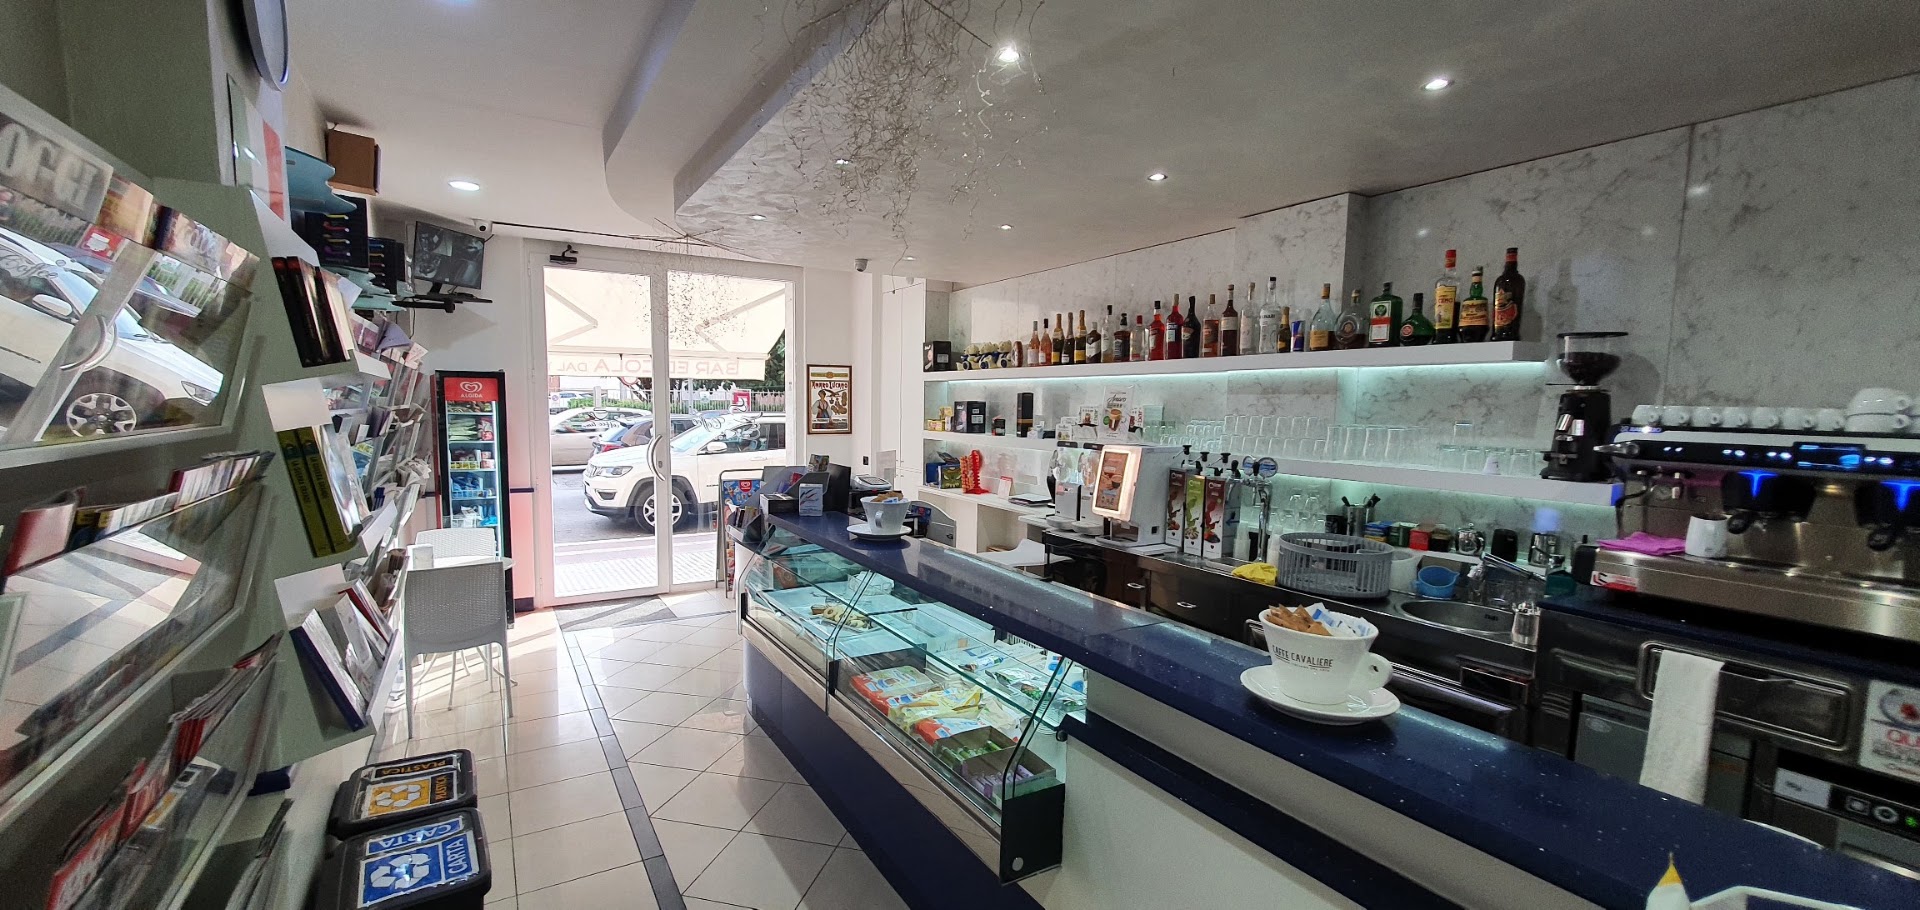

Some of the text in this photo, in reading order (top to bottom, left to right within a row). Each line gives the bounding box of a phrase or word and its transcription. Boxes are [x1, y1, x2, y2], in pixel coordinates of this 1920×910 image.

[1290, 652, 1334, 667] CAVALIERE
[381, 760, 447, 775] PLASTICA
[434, 775, 448, 801] PLASTICA
[379, 824, 452, 848] CARTA
[446, 838, 469, 874] CARTA
